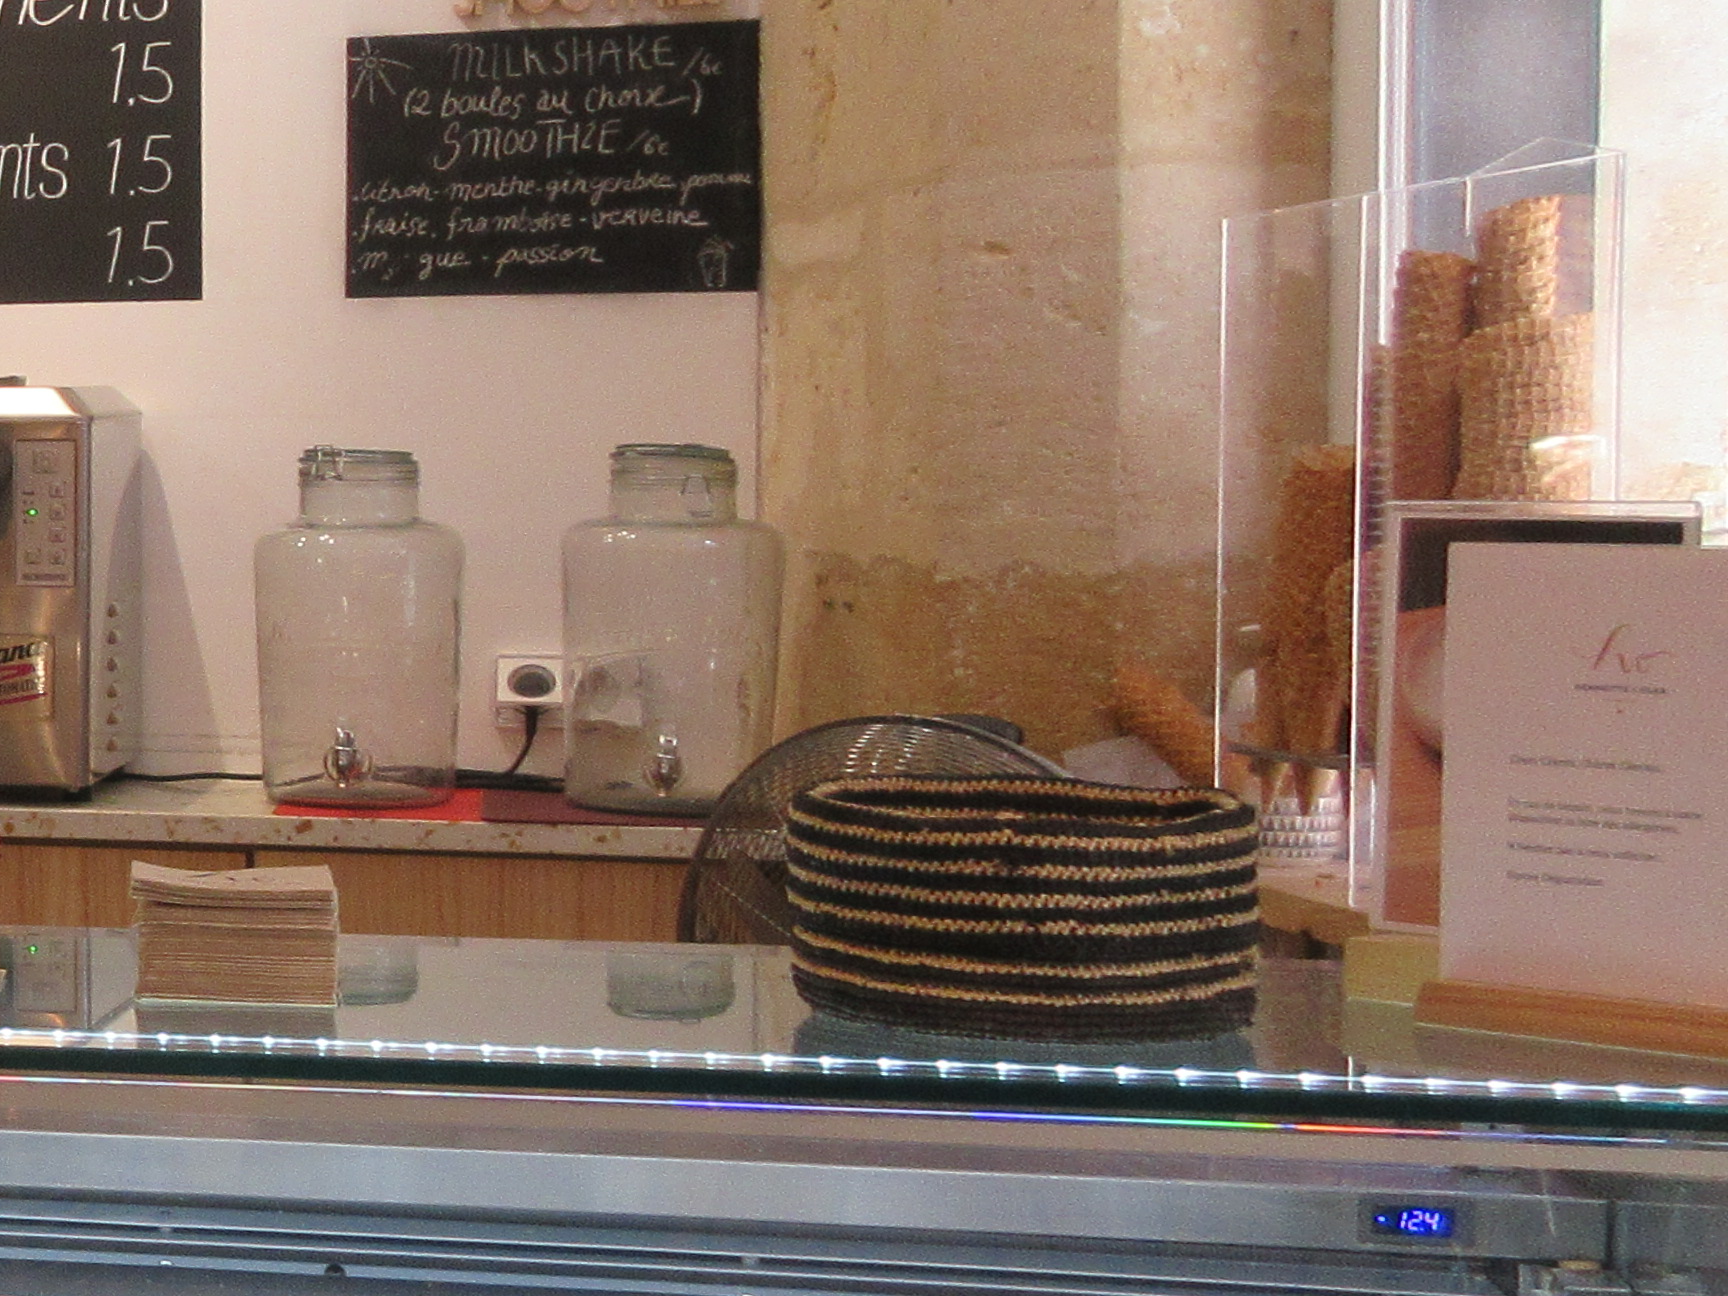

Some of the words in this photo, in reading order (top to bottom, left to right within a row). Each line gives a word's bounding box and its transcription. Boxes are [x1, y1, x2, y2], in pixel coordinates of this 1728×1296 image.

[111, 41, 174, 107] 1.5
[441, 86, 525, 119] boules
[537, 92, 572, 115] au
[107, 135, 173, 197] 1.5
[107, 221, 174, 286] 1.5
[496, 243, 604, 277] passion
